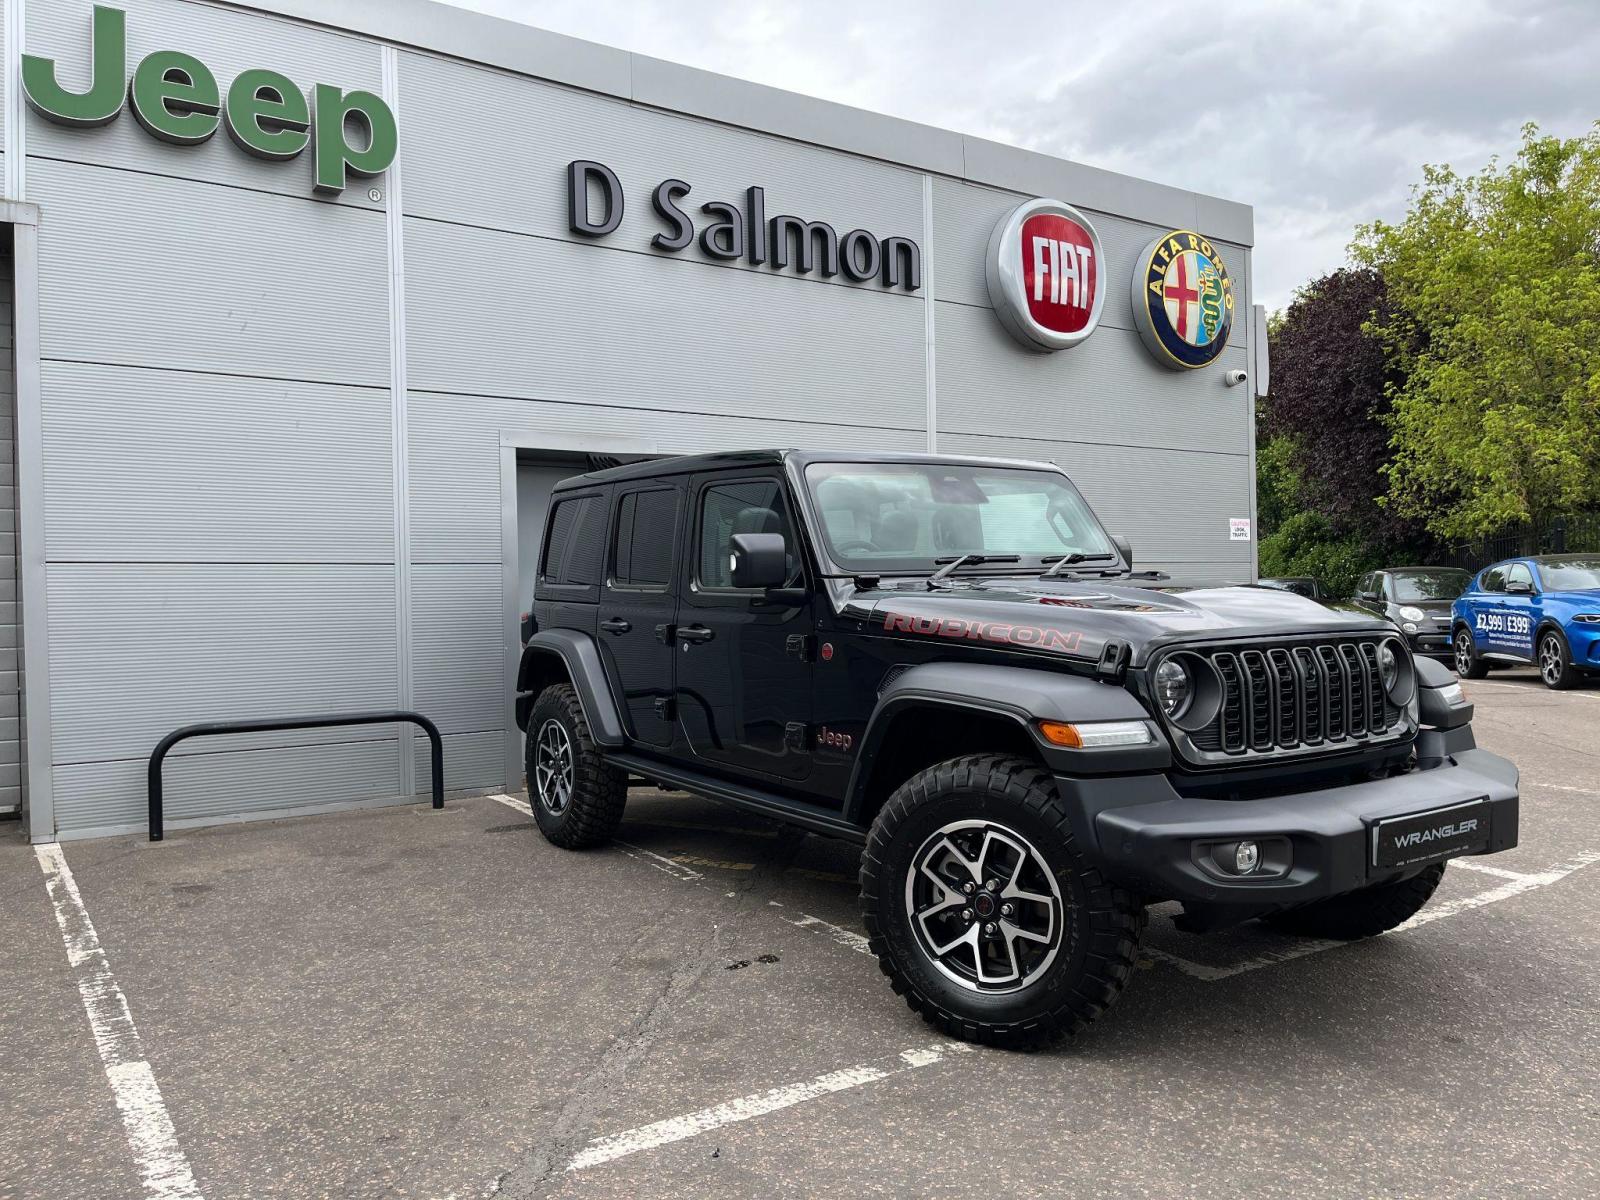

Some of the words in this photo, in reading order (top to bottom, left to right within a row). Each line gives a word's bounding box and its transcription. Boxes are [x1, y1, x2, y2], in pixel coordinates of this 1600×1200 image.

[20, 3, 399, 195] Jeep
[567, 160, 625, 238] D
[650, 178, 921, 292] Salmon
[1032, 236, 1093, 310] FIAT
[1149, 238, 1183, 297] ALFA
[1188, 234, 1233, 310] ROMEO
[882, 612, 1083, 652] RUBICON
[1476, 613, 1503, 632] £2,999
[1507, 615, 1528, 633] £399
[816, 726, 852, 752] Jeep
[1394, 818, 1479, 849] WRANGLER
